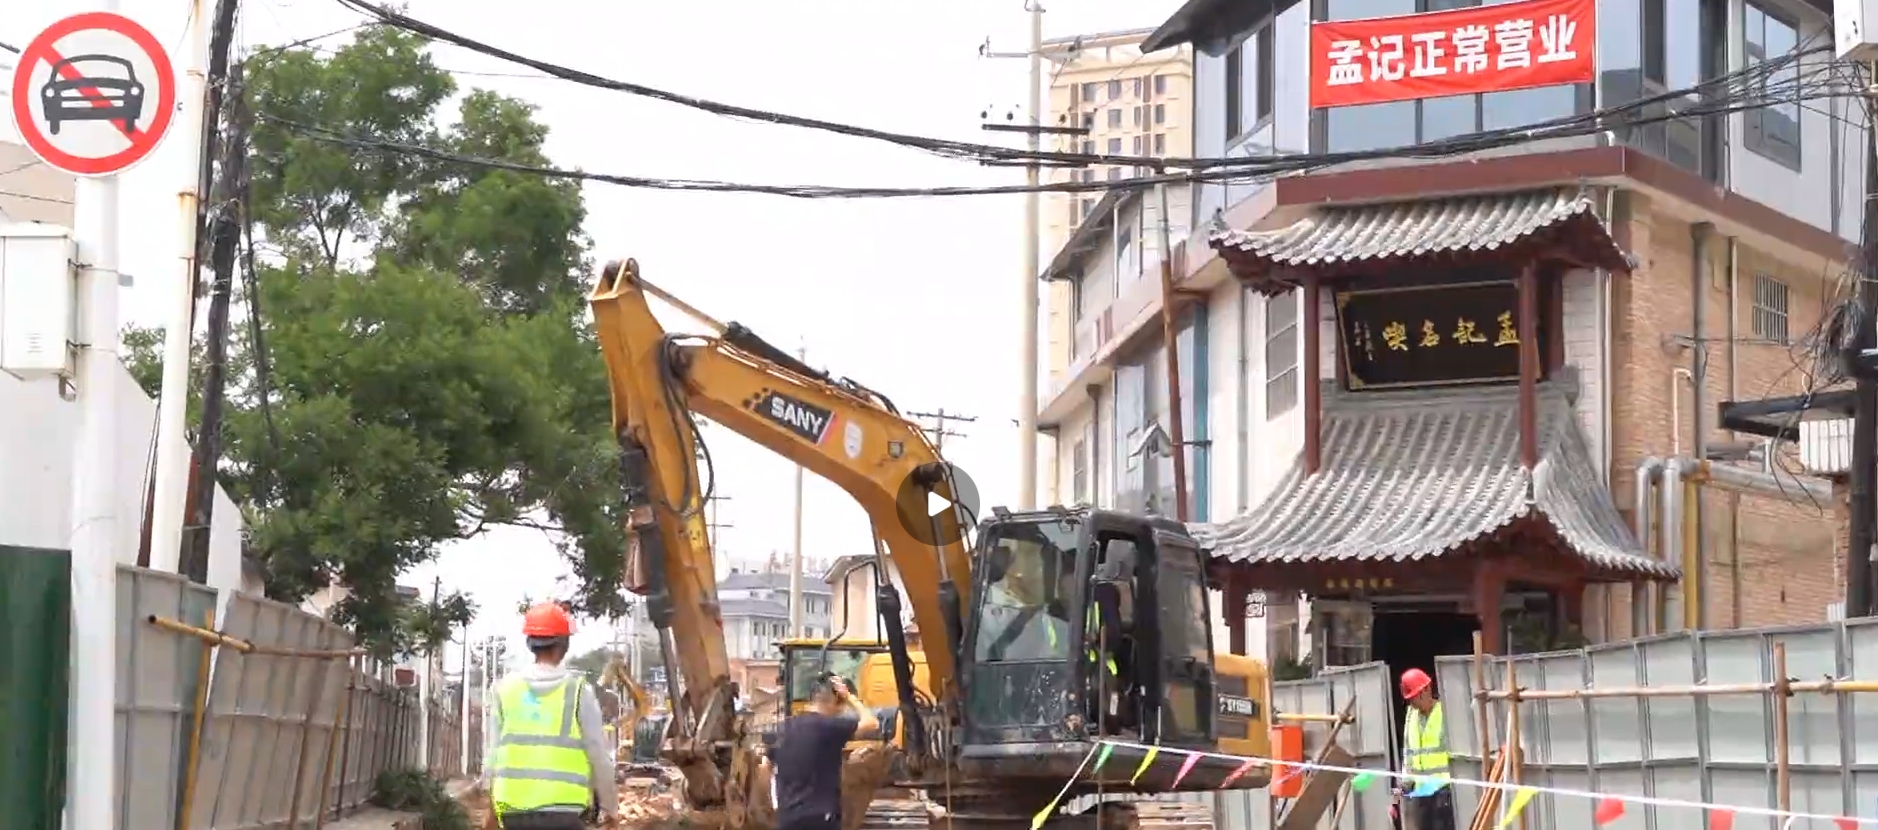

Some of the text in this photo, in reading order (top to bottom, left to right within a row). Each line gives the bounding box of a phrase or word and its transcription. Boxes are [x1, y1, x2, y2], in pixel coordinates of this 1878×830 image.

[1327, 14, 1577, 86] 孟记正常营业
[771, 396, 822, 435] SANY
